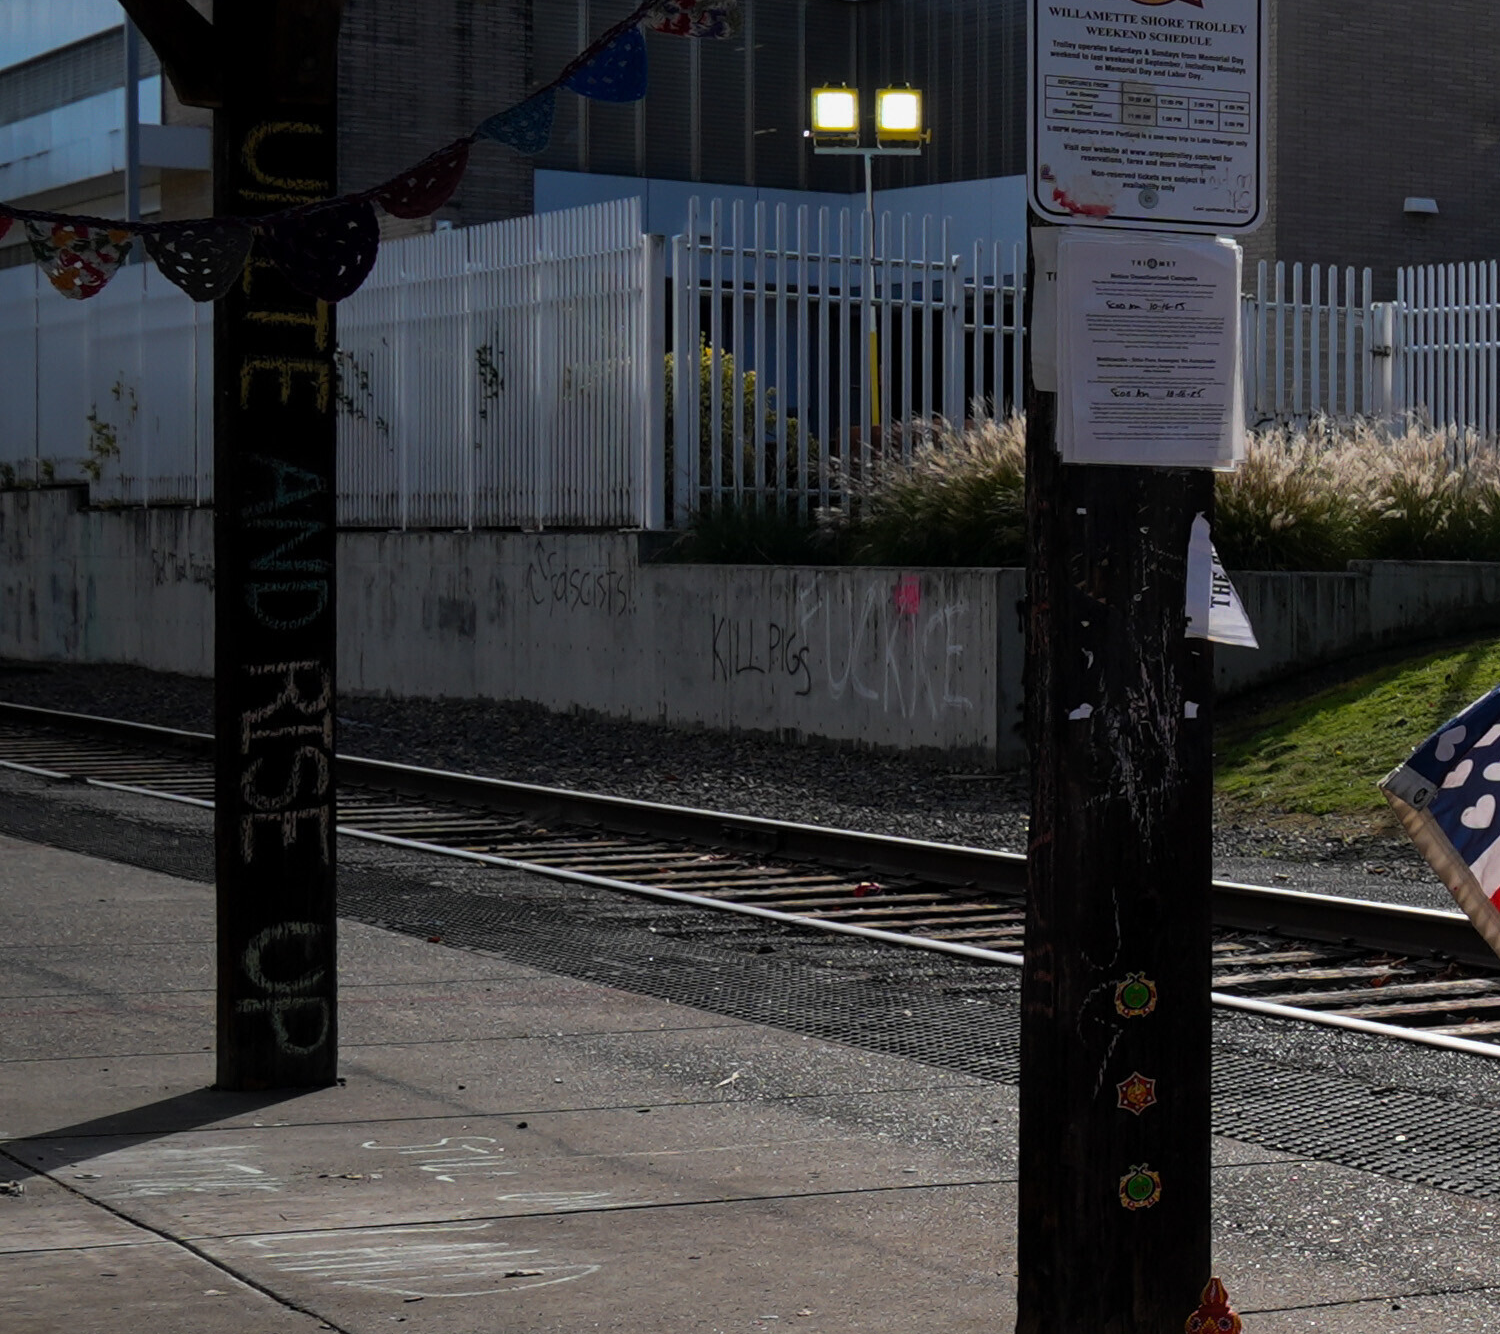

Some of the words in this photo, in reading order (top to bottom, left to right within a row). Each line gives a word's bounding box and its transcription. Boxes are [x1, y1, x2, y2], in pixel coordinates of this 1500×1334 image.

[1049, 7, 1138, 24] WILLAMETTE
[1141, 15, 1184, 28] SHORE
[1187, 20, 1247, 34] TROLLEY
[1086, 26, 1146, 40] WEEKEND
[1149, 32, 1212, 46] SCHEDULE
[1050, 51, 1080, 59] weekend
[1090, 53, 1103, 61] last
[1105, 55, 1134, 64] weekend
[1185, 62, 1215, 73] including
[1217, 64, 1246, 75] Mondays
[1052, 40, 1076, 50] Trolley
[1078, 43, 1107, 52] operates
[1109, 45, 1142, 55] Saturdays
[1152, 49, 1179, 59] Sundays
[1181, 51, 1197, 60] from
[1198, 53, 1229, 63] Memorial
[1231, 56, 1244, 65] Day
[1105, 64, 1137, 74] Memorial
[1139, 67, 1152, 76] Day
[1167, 70, 1186, 78] Labor
[1188, 72, 1204, 81] Day.
[1071, 127, 1099, 135] departure
[1116, 130, 1140, 138] Portland
[1212, 138, 1234, 146] Oswego
[1236, 140, 1248, 148] only
[1063, 143, 1079, 151] Visit
[1093, 146, 1120, 154] website
[1223, 154, 1232, 162] for
[1126, 157, 1143, 165] fares
[1178, 161, 1216, 170] information
[1091, 170, 1135, 179] Non-reserved
[1138, 173, 1159, 181] tickets
[1174, 175, 1198, 185] subject
[1161, 185, 1175, 193] only
[241, 452, 328, 631] AND
[1209, 572, 1231, 609] THE
[712, 614, 766, 682] KILL
[797, 573, 907, 719] FUCK
[905, 600, 974, 721] ICE
[240, 660, 332, 866] RISE
[236, 921, 331, 1056] UP
